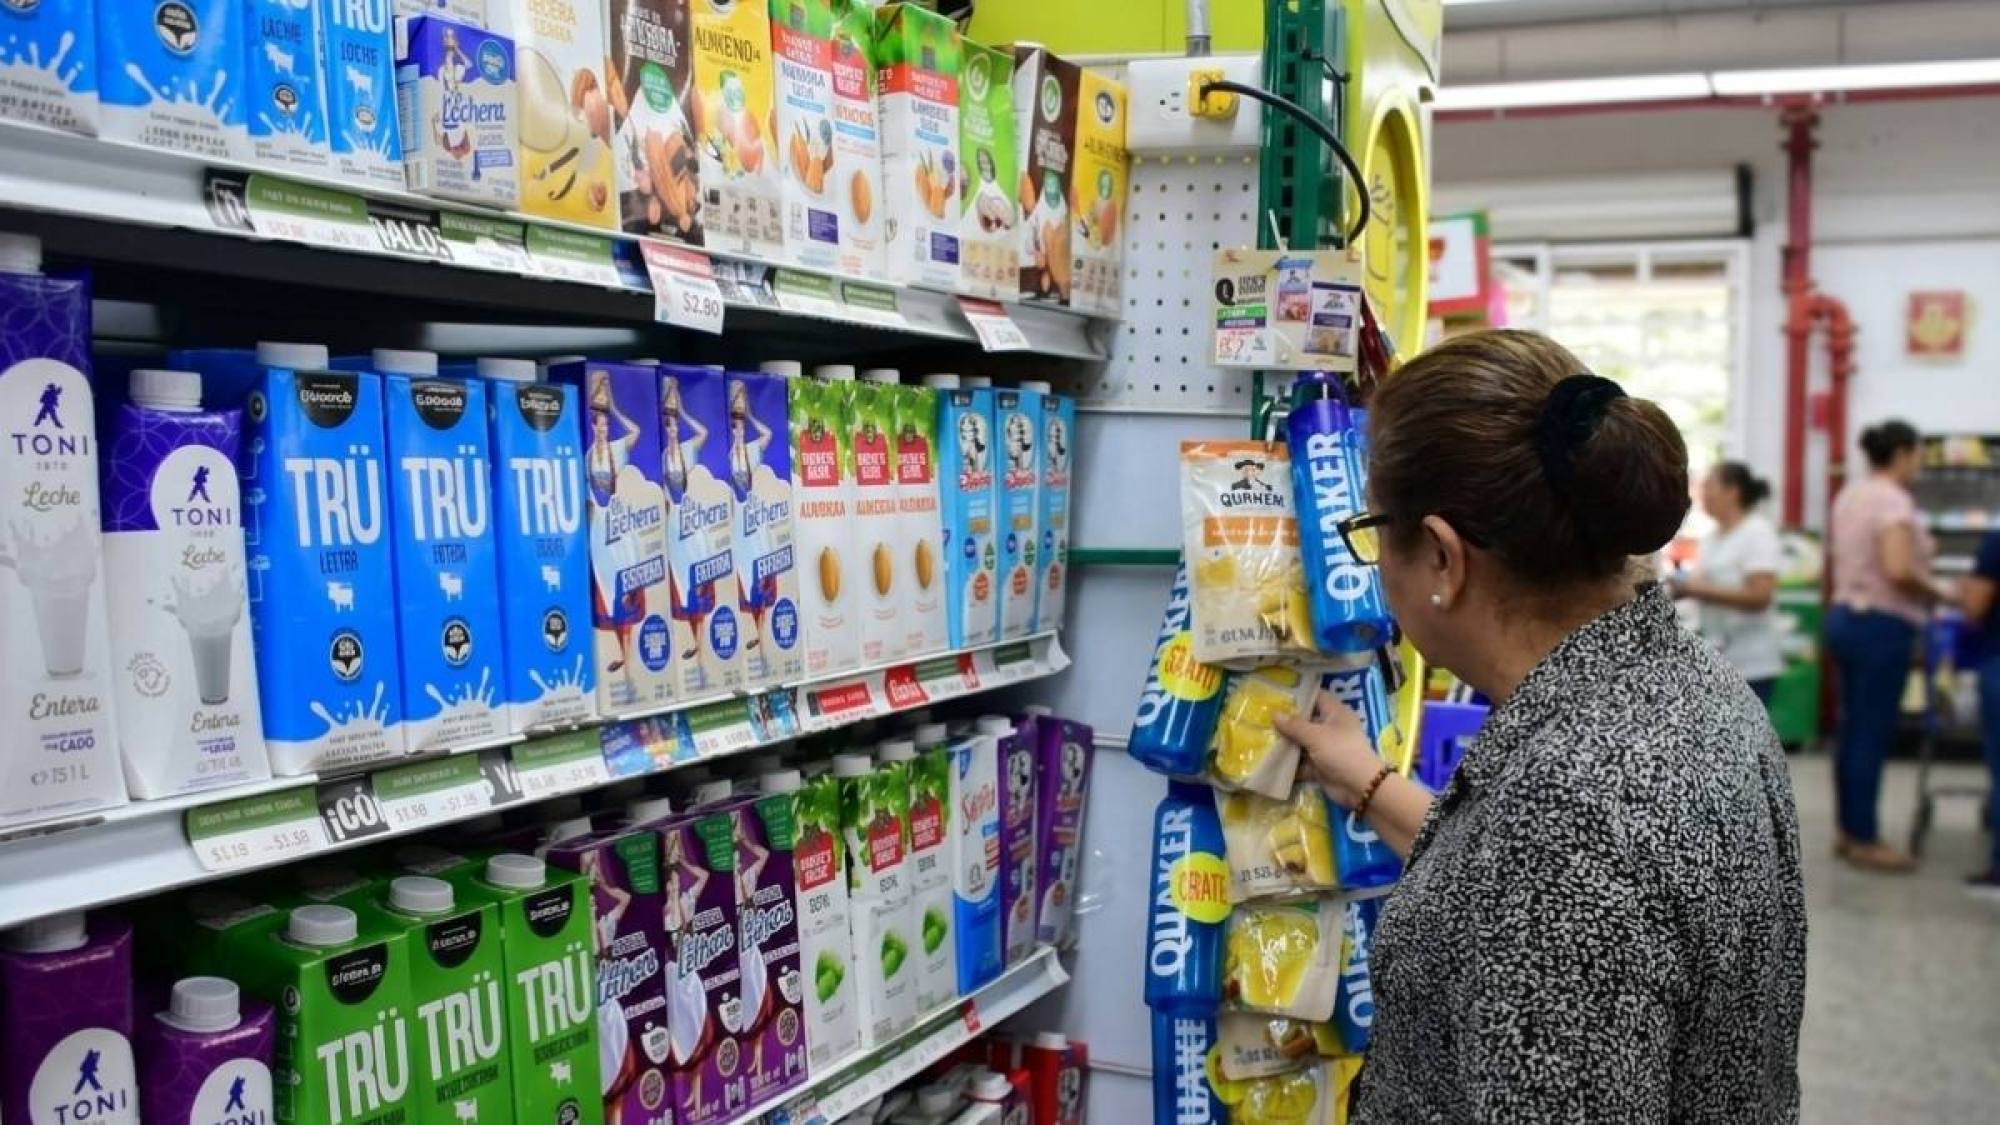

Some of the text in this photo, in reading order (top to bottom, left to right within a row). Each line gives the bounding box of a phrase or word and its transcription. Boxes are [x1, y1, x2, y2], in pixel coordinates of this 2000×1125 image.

[12, 433, 88, 455] TONI
[23, 481, 81, 512] Leche
[171, 508, 232, 525] TONI
[285, 445, 381, 547] TRÜ
[401, 445, 486, 541] TRÜ
[509, 446, 581, 536] TRÜ
[29, 693, 99, 720] Entera
[418, 970, 501, 1081] TRÜ
[517, 941, 591, 1044] TRÜ
[54, 1088, 127, 1125] TONI
[317, 1007, 410, 1125] TRÜ
